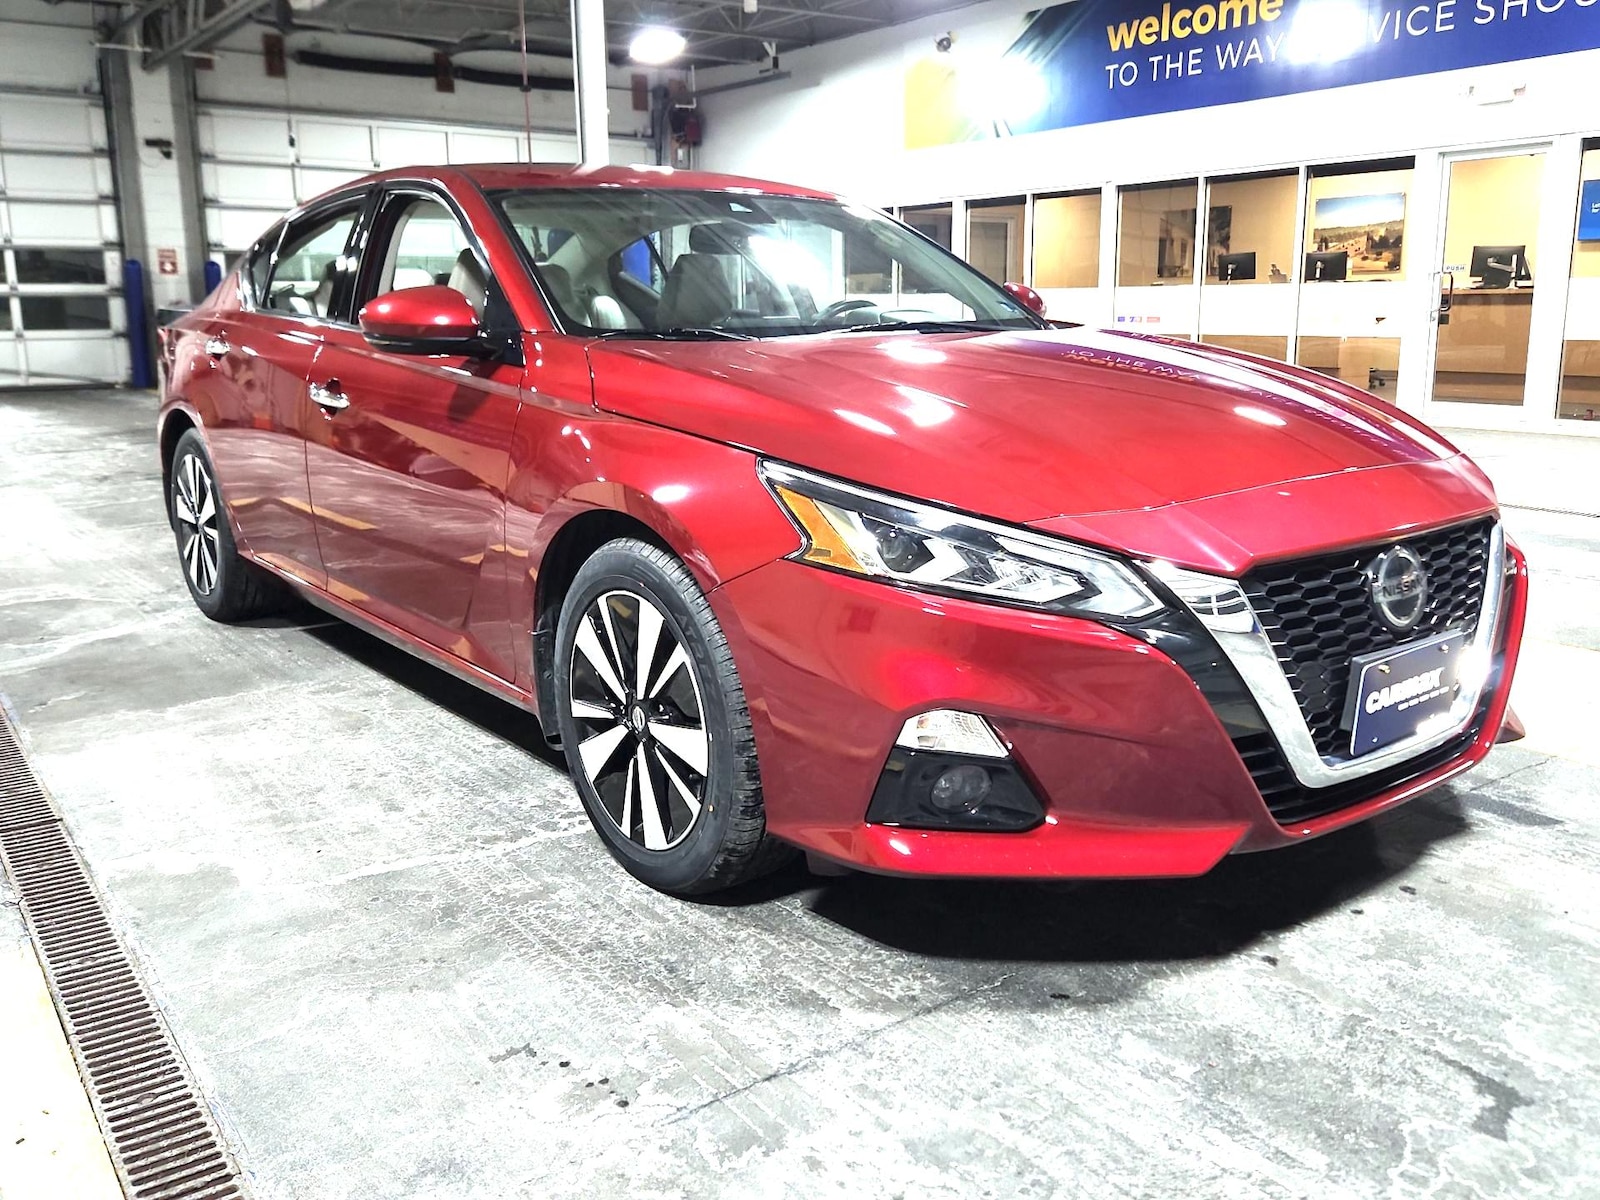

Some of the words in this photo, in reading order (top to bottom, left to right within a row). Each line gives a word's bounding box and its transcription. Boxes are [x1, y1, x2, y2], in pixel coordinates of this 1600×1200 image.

[1106, 0, 1284, 52] welcome
[1105, 61, 1139, 90] TO
[1148, 48, 1204, 82] THE
[1215, 32, 1285, 71] WAY
